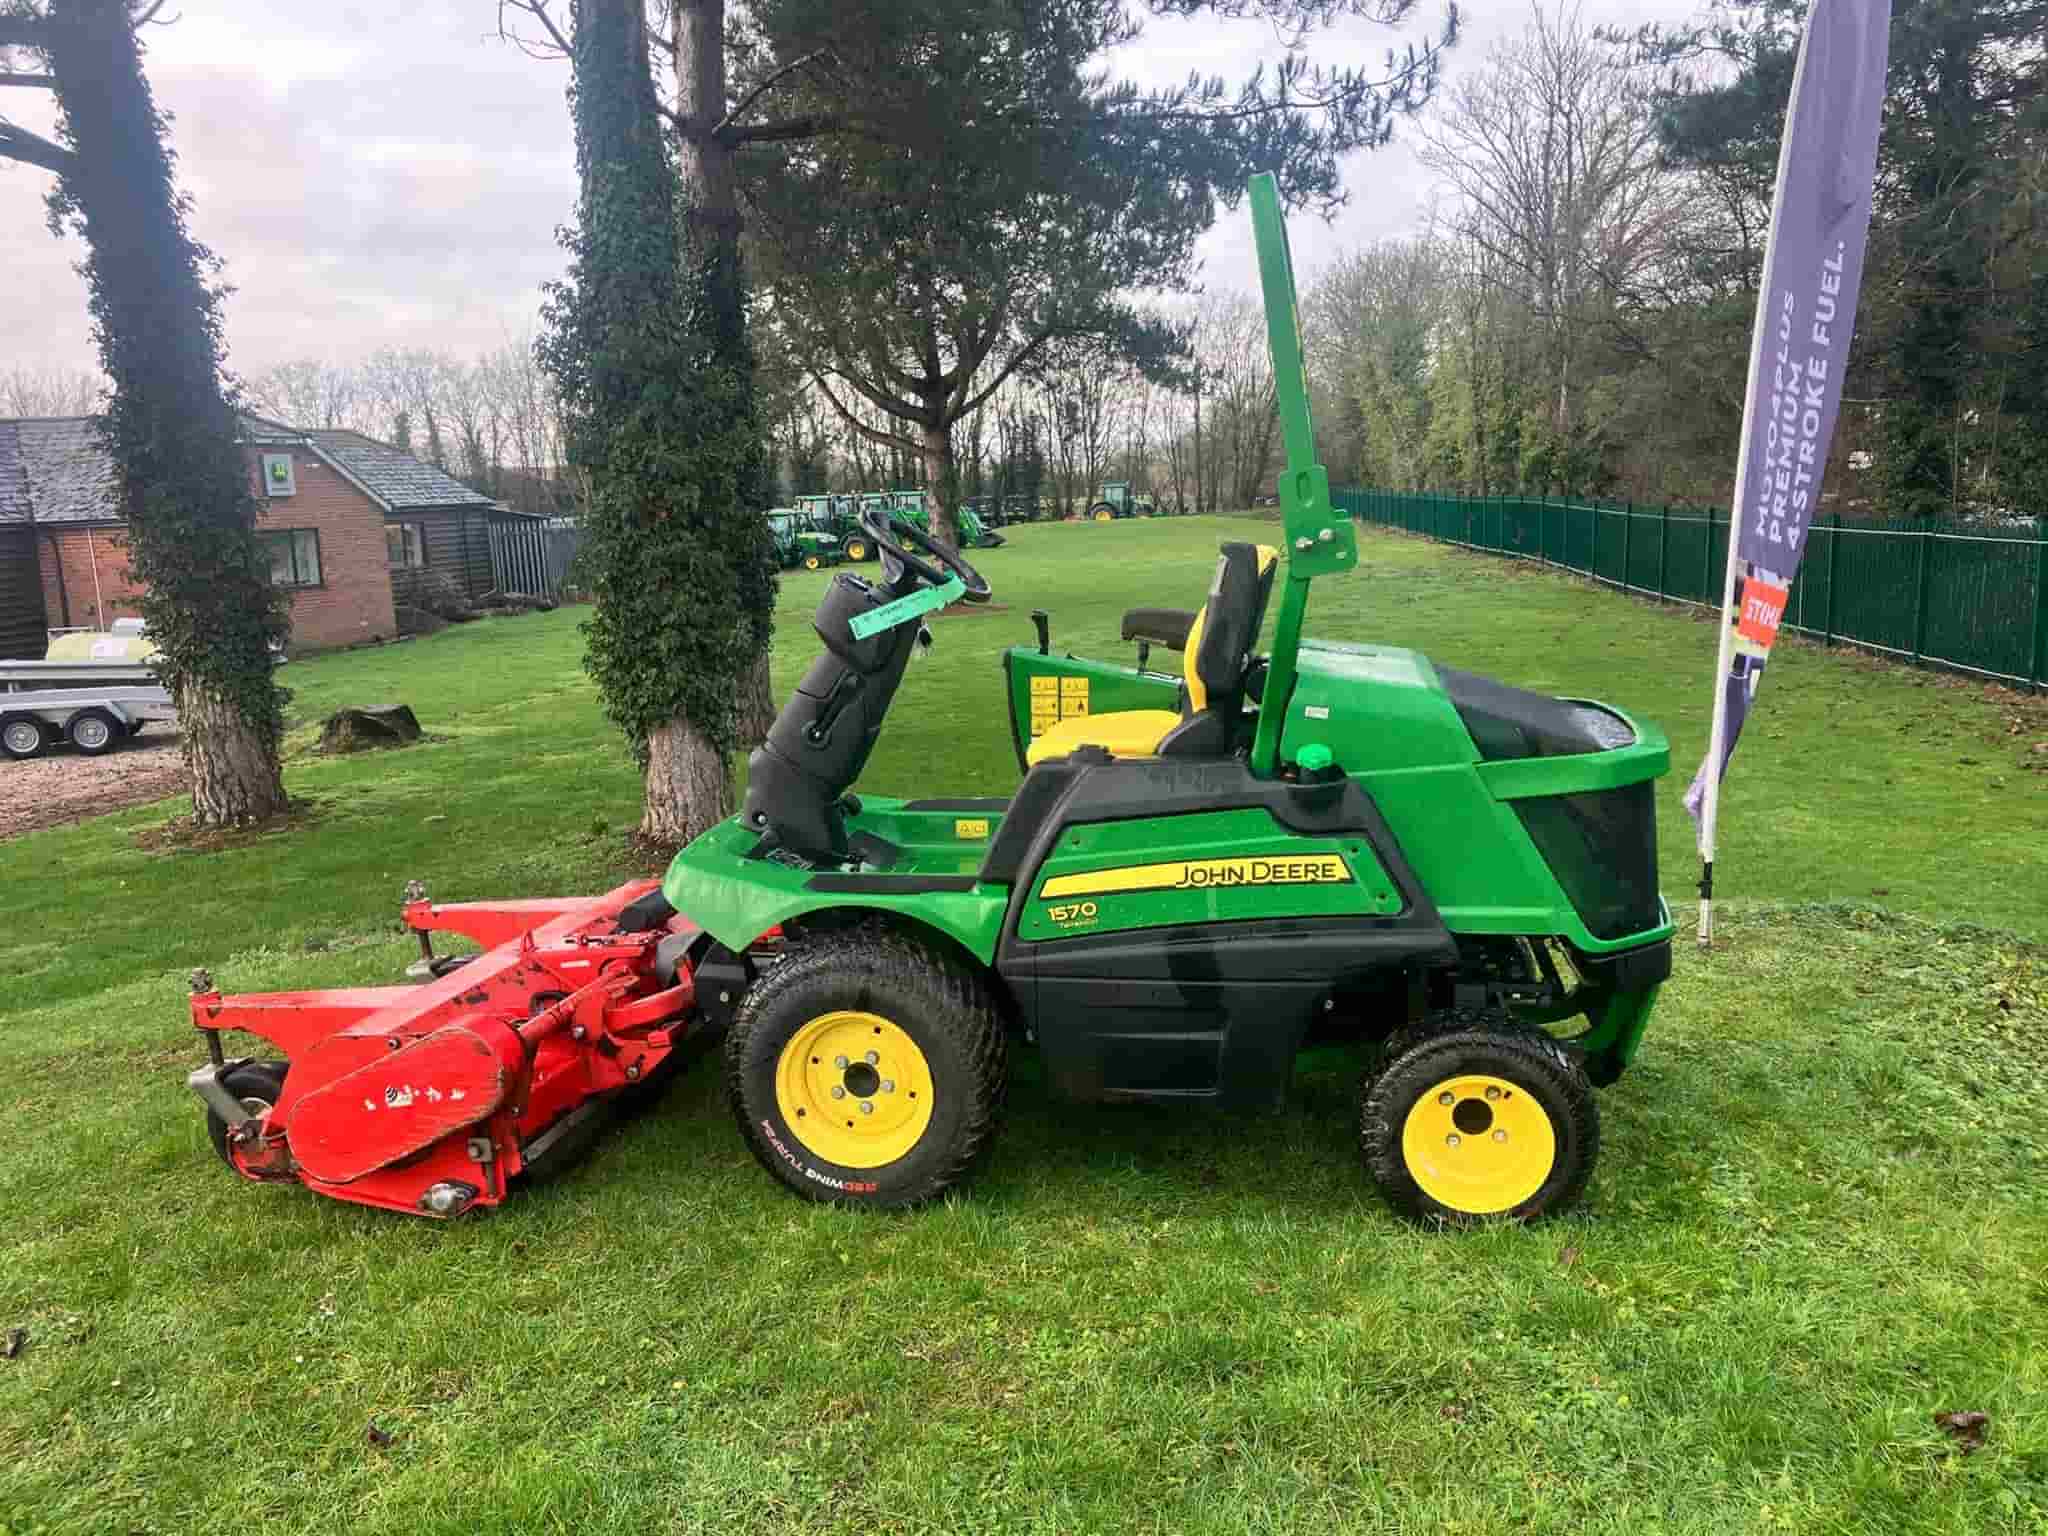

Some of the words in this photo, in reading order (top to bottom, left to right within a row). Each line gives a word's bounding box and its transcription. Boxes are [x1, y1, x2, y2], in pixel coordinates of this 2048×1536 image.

[1787, 355, 1828, 550] 4-STROKE
[1812, 240, 1845, 346] FUEL.
[1769, 361, 1803, 543] PREMIUM
[1048, 902, 1097, 920] 1570
[1176, 864, 1244, 885] JOHN
[1252, 862, 1336, 880] DEERE
